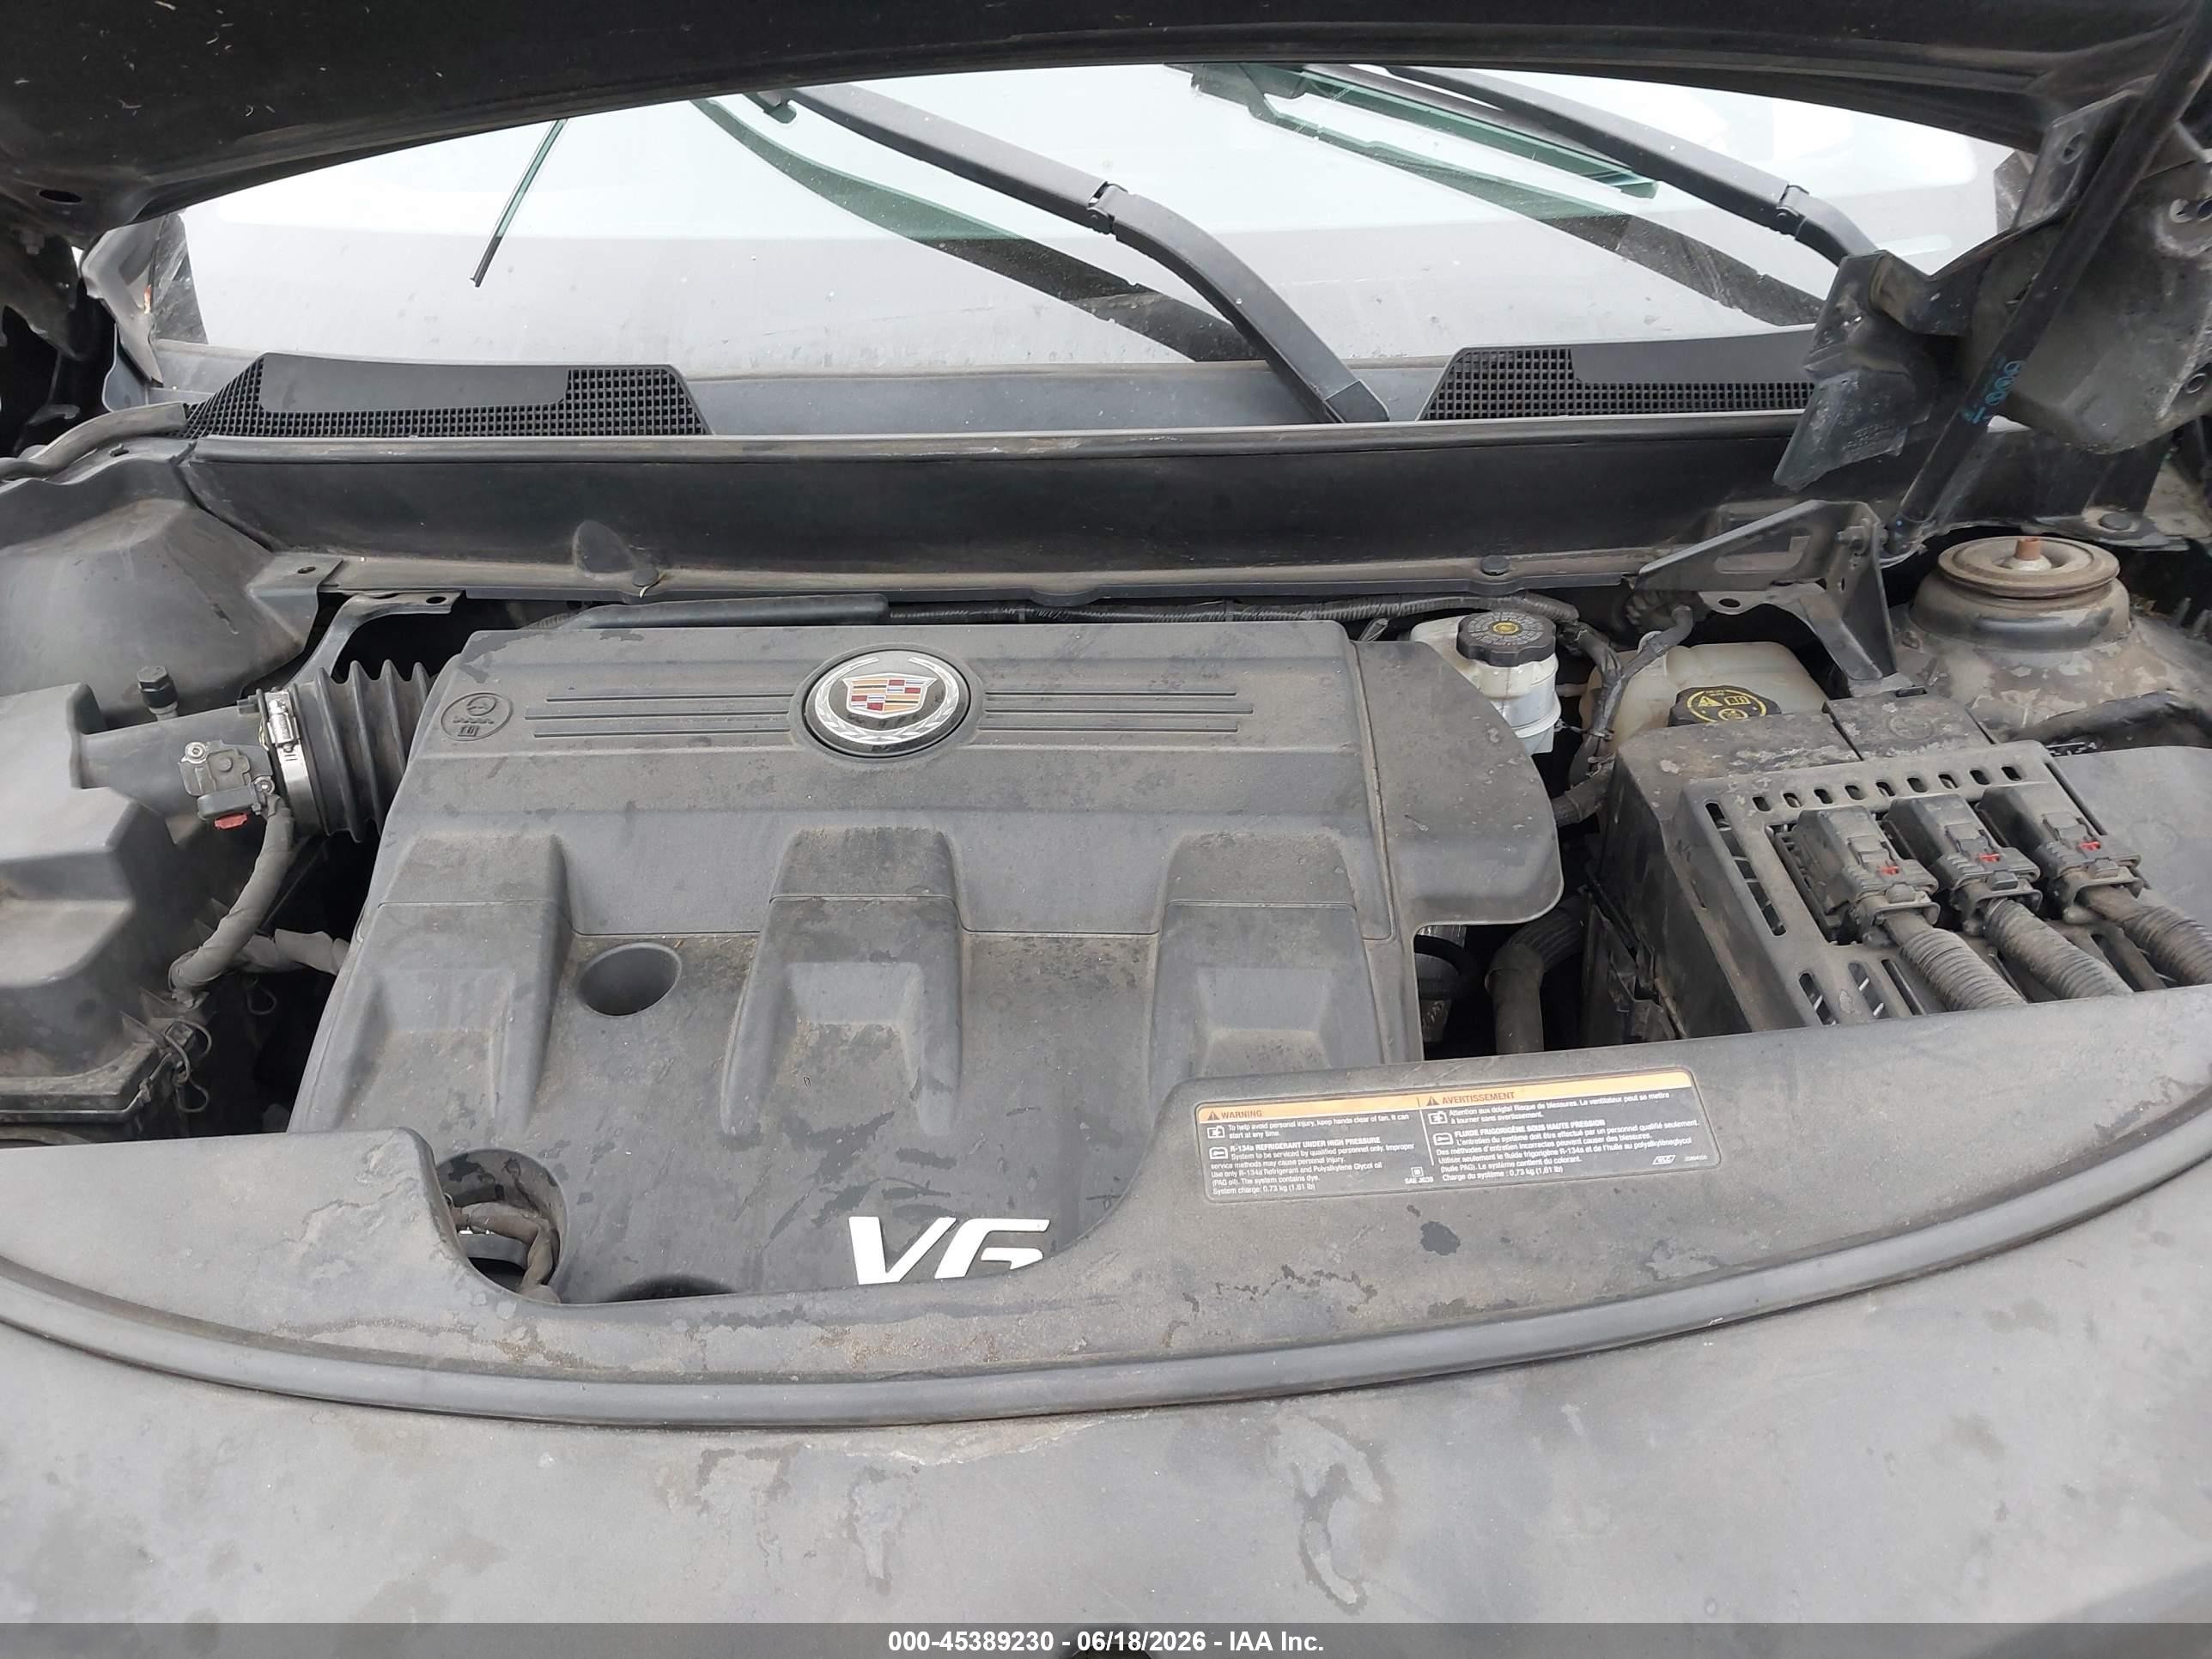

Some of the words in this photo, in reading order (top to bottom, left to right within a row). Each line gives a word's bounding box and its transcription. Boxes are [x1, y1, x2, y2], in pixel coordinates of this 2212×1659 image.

[1443, 1092, 1515, 1105] AVERTISSEMENT
[1449, 1108, 1477, 1116] Attention
[1491, 1104, 1512, 1114] doigts!
[1514, 1103, 1535, 1112] Risque
[1547, 1099, 1578, 1108] blessures.
[1589, 1096, 1622, 1104] ventilateur
[1623, 1095, 1638, 1103] peut
[1221, 1109, 1262, 1119] WARNING
[1498, 1111, 1544, 1121] avertissement.
[1237, 1123, 1250, 1132] help
[1269, 1121, 1296, 1130] personal
[1297, 1120, 1316, 1128] injury,
[1316, 1118, 1333, 1127] keep
[1455, 1128, 1480, 1138] FLUIDE
[1527, 1123, 1546, 1132] SOUS
[1547, 1121, 1570, 1130] HAUTE
[1571, 1119, 1606, 1128] PRESSION
[1456, 1137, 1491, 1146] L'entretien
[1501, 1133, 1528, 1144] système
[1557, 1129, 1583, 1138] effectué
[1607, 1125, 1638, 1134] personnel
[1639, 1122, 1663, 1132] qualifié
[1664, 1120, 1699, 1128] seulement.
[1255, 1141, 1302, 1150] REFRIGERANT
[1345, 1137, 1381, 1146] PRESSURE
[1450, 1146, 1482, 1154] méthodes
[1483, 1143, 1518, 1152] d'entretien
[1519, 1140, 1555, 1149] incorrectes
[1556, 1138, 1582, 1147] peuvent
[1619, 1133, 1652, 1141] blessures.
[1231, 1152, 1255, 1161] System
[1310, 1147, 1336, 1157] qualified
[1338, 1146, 1369, 1155] personnel
[1370, 1145, 1384, 1153] only.
[1385, 1143, 1415, 1152] Improper
[1462, 1153, 1496, 1162] seulement
[1297, 1157, 1325, 1165] personal
[1327, 1155, 1345, 1164] injury.
[1440, 1164, 1459, 1174] (huile
[1487, 1160, 1516, 1170] système
[1516, 1158, 1542, 1167] contient
[1263, 1166, 1298, 1176] Refrigerant
[1353, 1162, 1373, 1170] Glycol
[1212, 1178, 1227, 1187] (PAG
[1255, 1176, 1278, 1185] system
[1306, 1174, 1320, 1182] dye.
[1443, 1173, 1466, 1182] Charge
[1477, 1170, 1504, 1180] système
[1212, 1188, 1237, 1196] System
[1279, 1184, 1287, 1193] kg
[848, 1216, 1051, 1285] V6
